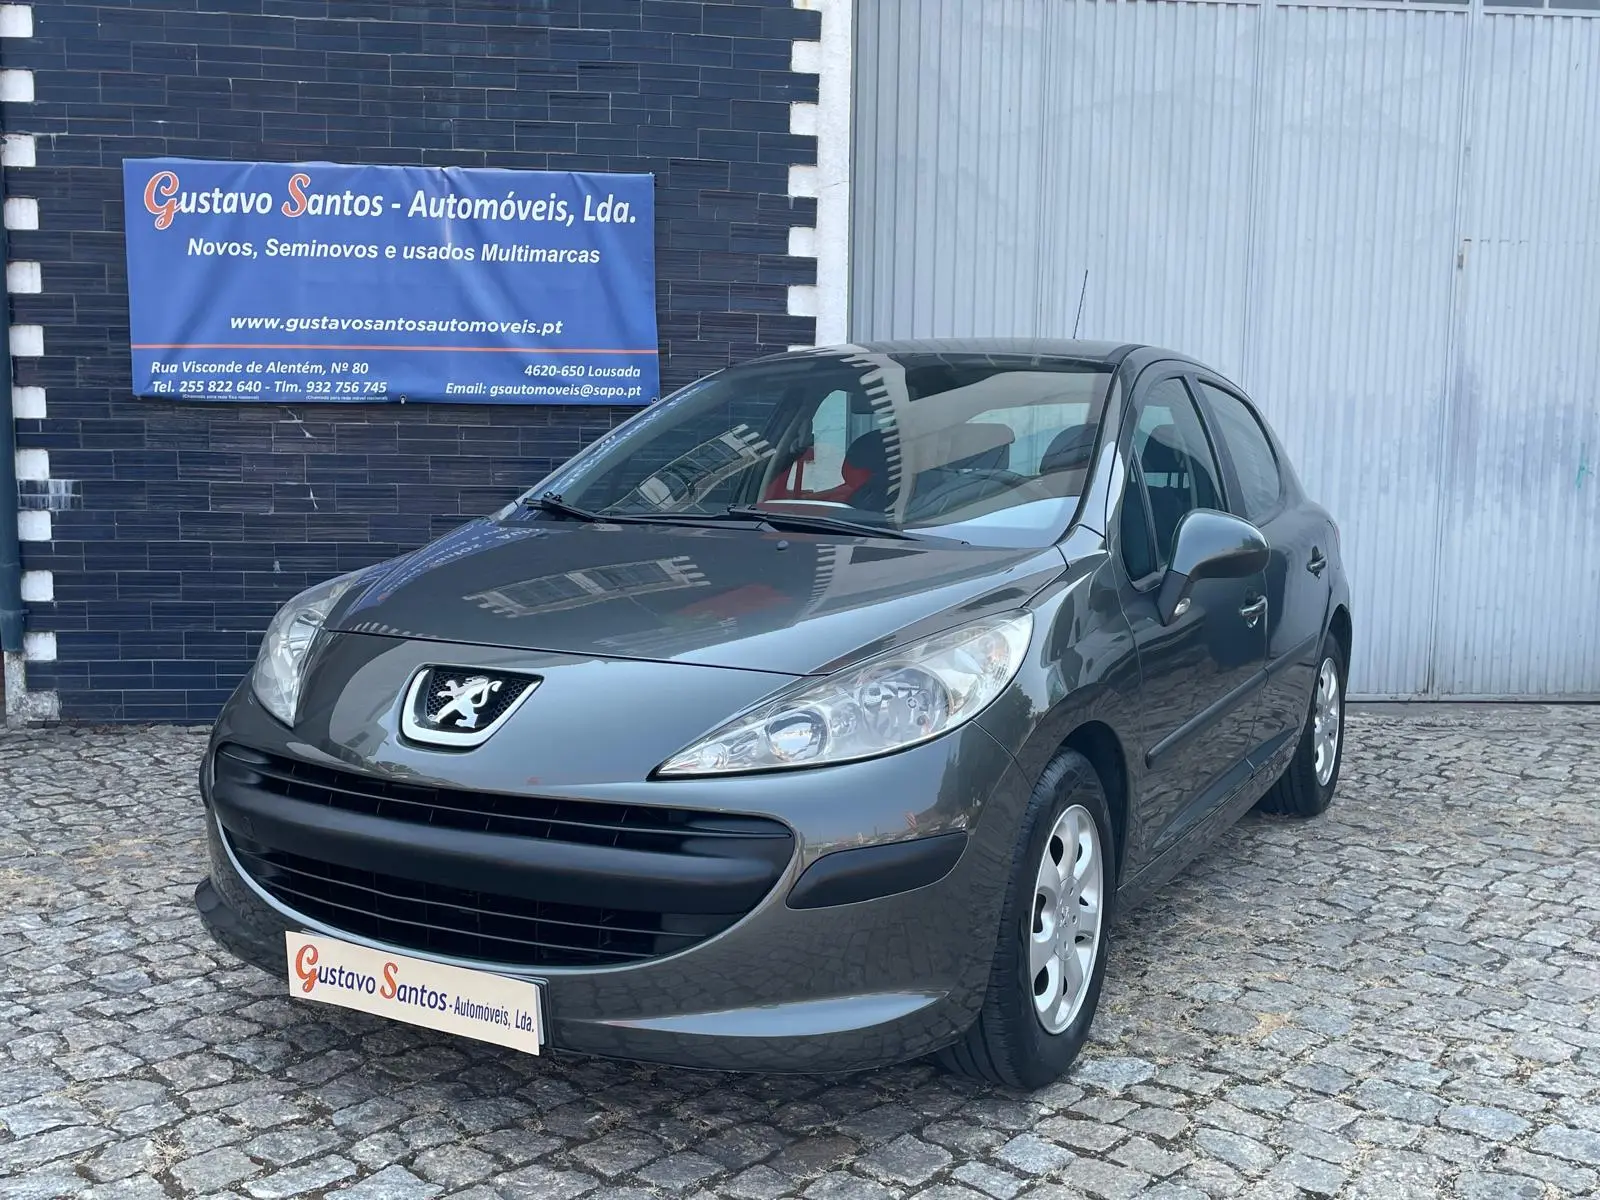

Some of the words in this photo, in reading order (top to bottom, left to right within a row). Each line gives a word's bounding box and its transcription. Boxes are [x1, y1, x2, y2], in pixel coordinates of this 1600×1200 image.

[144, 171, 272, 230] Gustavo
[281, 173, 383, 218] Santos
[408, 190, 575, 226] Automóveis,
[583, 194, 636, 224] Lda.
[187, 238, 258, 259] Novos,
[265, 238, 378, 258] Seminovos
[384, 244, 397, 259] e
[403, 243, 475, 262] usados
[481, 243, 600, 263] Multimarcas
[230, 315, 564, 336] www.gustavosantosautomoveis.pt
[151, 361, 178, 374] Rua
[182, 360, 243, 374] Visconde
[246, 361, 263, 374] de
[265, 361, 327, 376] Alentém,
[352, 362, 369, 375] 80
[524, 364, 585, 377] 4620-650
[588, 364, 641, 378] Lousada
[152, 381, 176, 393] Tel.
[179, 381, 204, 393] 255
[208, 381, 233, 393] 822
[236, 381, 262, 393] 640
[274, 381, 302, 393] Tlm.
[306, 381, 331, 393] 932
[335, 381, 360, 394] 756
[363, 381, 387, 393] 745
[445, 382, 487, 395] Email:
[490, 383, 642, 398] gsautomoveis@sapo.pt
[295, 944, 376, 993] Gustavo
[515, 1008, 535, 1033] Lda.
